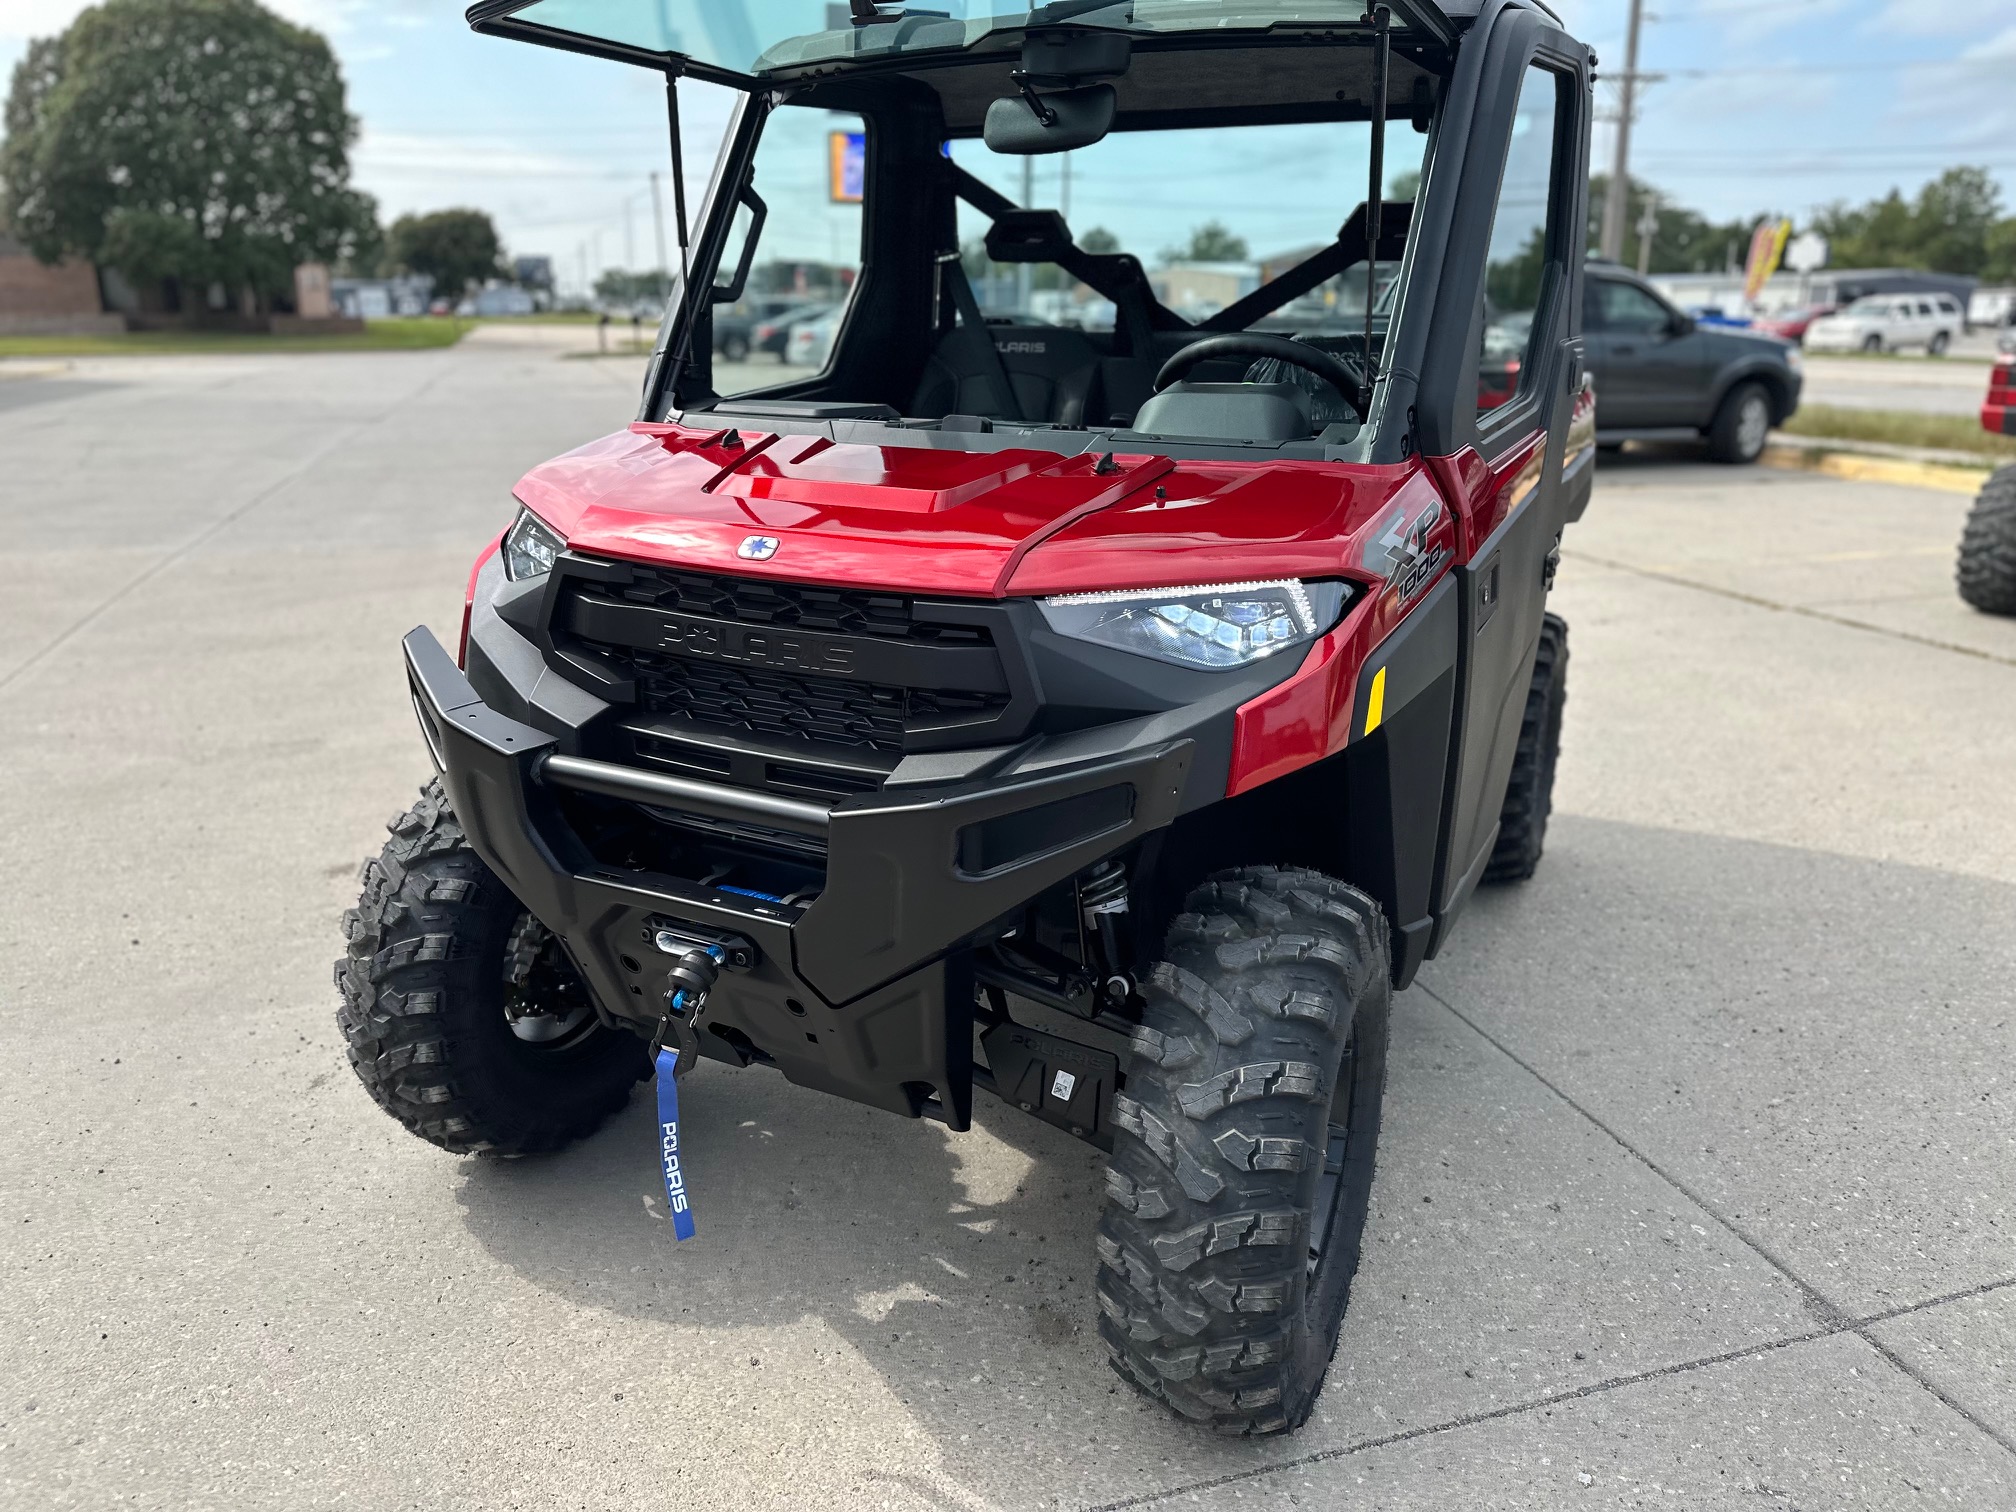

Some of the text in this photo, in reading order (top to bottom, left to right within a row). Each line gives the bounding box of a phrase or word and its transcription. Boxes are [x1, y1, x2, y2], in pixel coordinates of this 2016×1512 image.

[994, 341, 1046, 353] LARIS
[1379, 499, 1441, 600] XP
[1397, 541, 1442, 606] 1000
[655, 617, 855, 673] POLARIS
[1010, 1033, 1113, 1070] POLARIS
[663, 1122, 688, 1213] POLARIS
